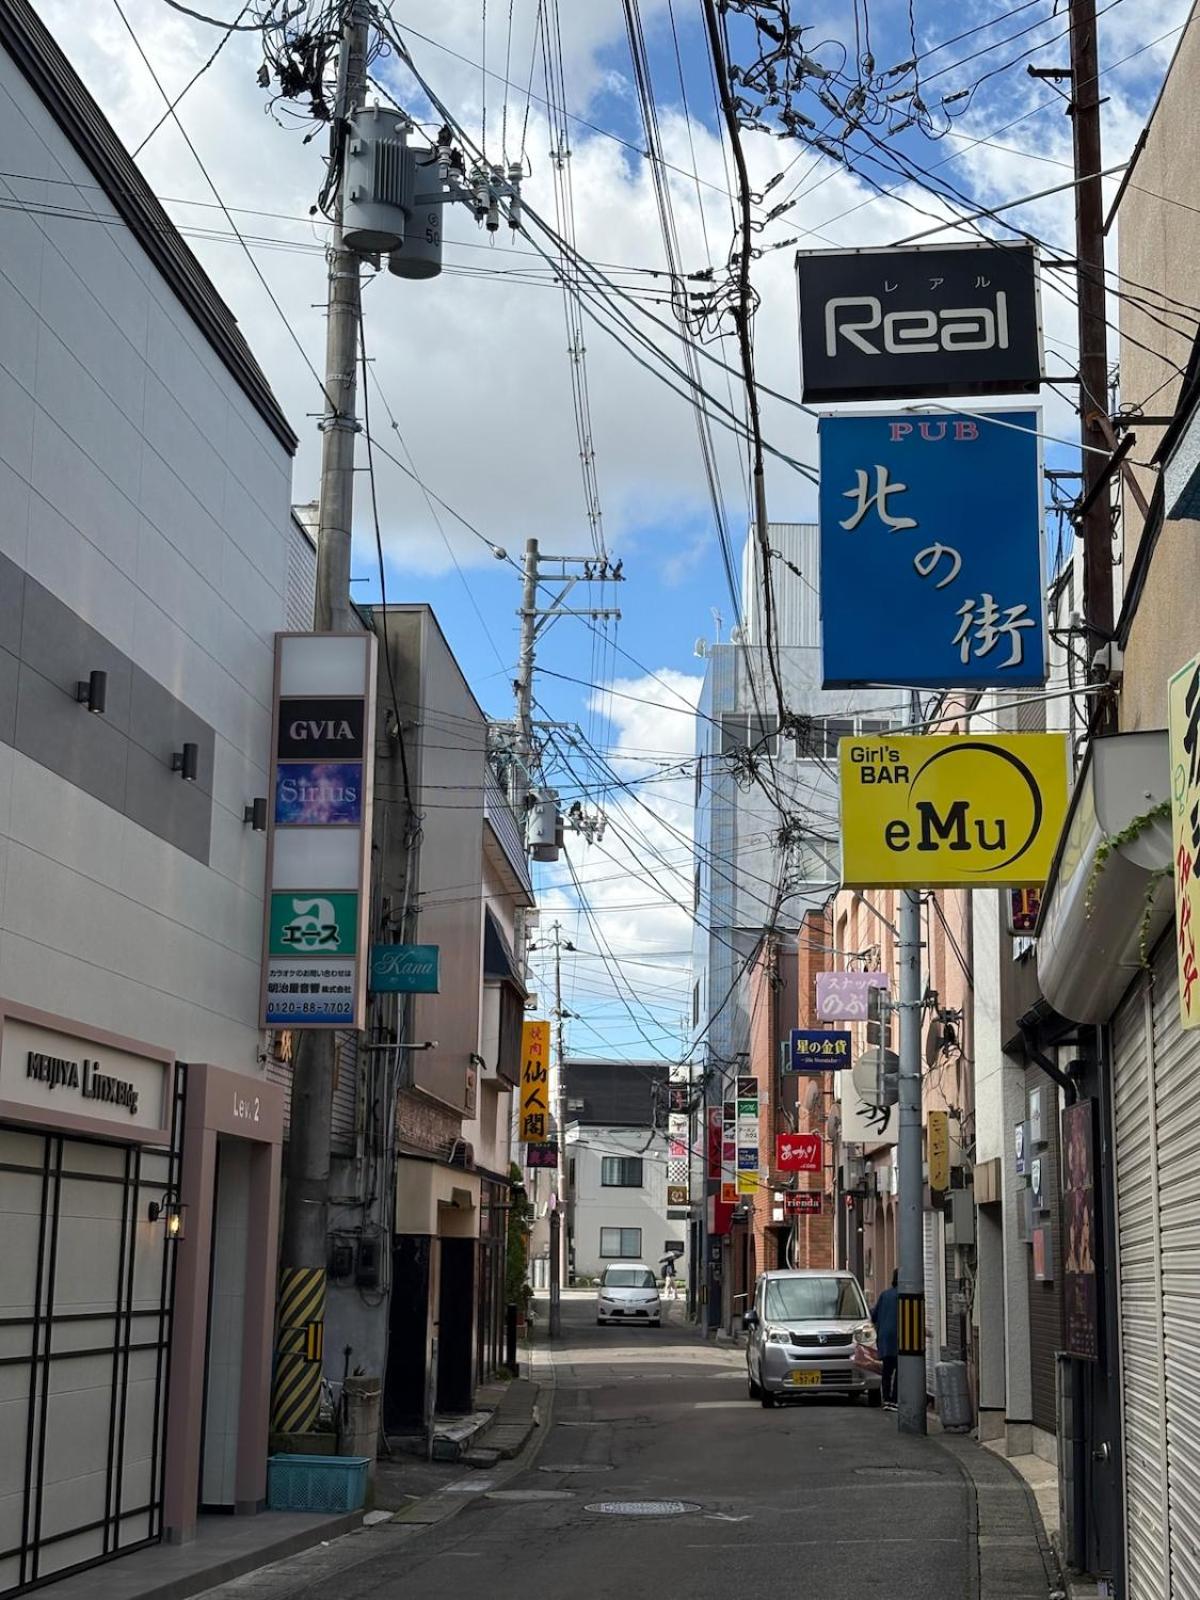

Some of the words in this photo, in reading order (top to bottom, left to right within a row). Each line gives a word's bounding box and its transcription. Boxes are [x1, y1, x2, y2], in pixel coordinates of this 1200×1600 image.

[825, 291, 1008, 357] Real
[888, 421, 979, 441] PUB
[838, 465, 1035, 669] 北の街
[289, 720, 355, 741] GVIA
[850, 746, 900, 763] Girl's
[861, 765, 909, 784] BAR
[280, 777, 357, 803] Sirius
[885, 801, 1006, 851] eMu
[283, 923, 341, 945] エース
[269, 969, 351, 978] カラオケのお問い合わせは
[268, 1002, 352, 1014] 0120-88-7702
[796, 1039, 847, 1056] 星の金貨
[26, 1051, 79, 1089] MEIJIYA
